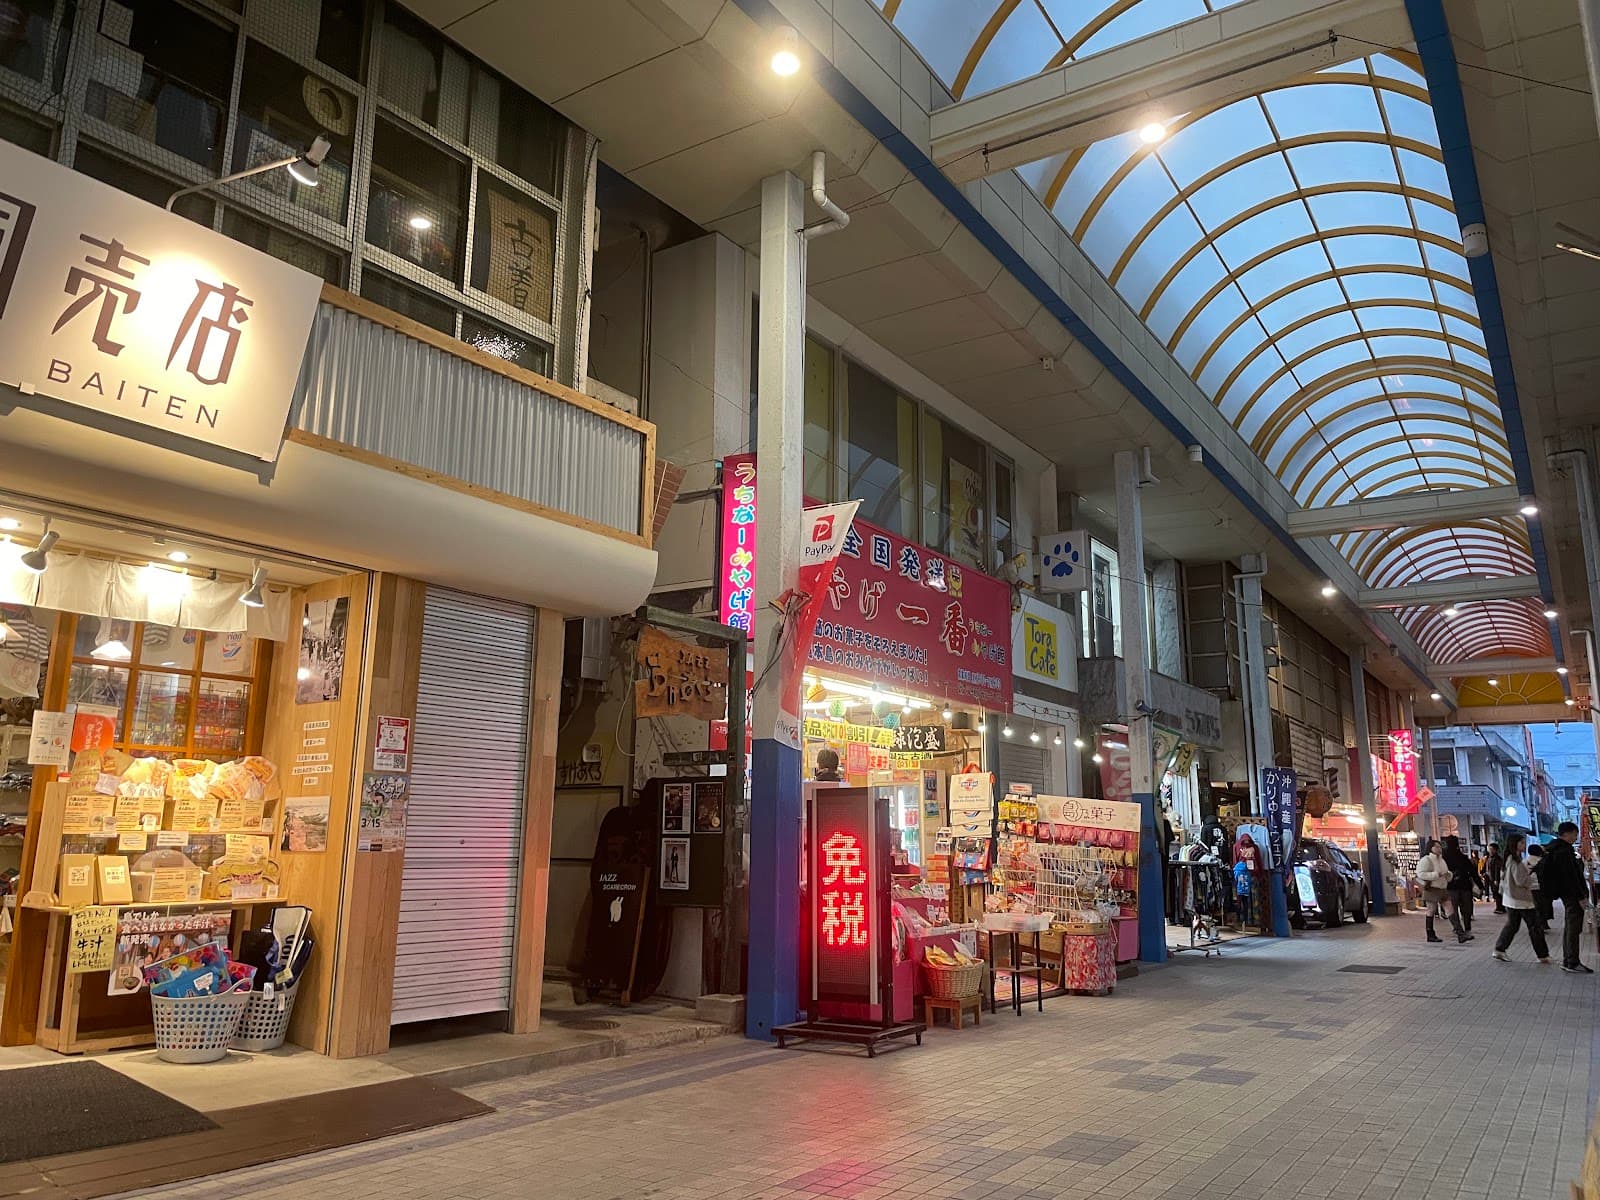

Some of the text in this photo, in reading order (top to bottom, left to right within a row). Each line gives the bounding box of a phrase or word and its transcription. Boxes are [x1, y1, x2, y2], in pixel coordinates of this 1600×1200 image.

[47, 359, 220, 428] BAITEN
[728, 461, 756, 633] うちなーみやげ館
[804, 543, 836, 557] PayPay
[1026, 617, 1053, 650] Tora
[808, 641, 929, 687] 本島のおみやげがいっぱい!
[361, 817, 381, 828] 3/15
[599, 873, 617, 882] JAZZ
[603, 883, 637, 891] SCARECROW
[822, 832, 867, 945] 免税
